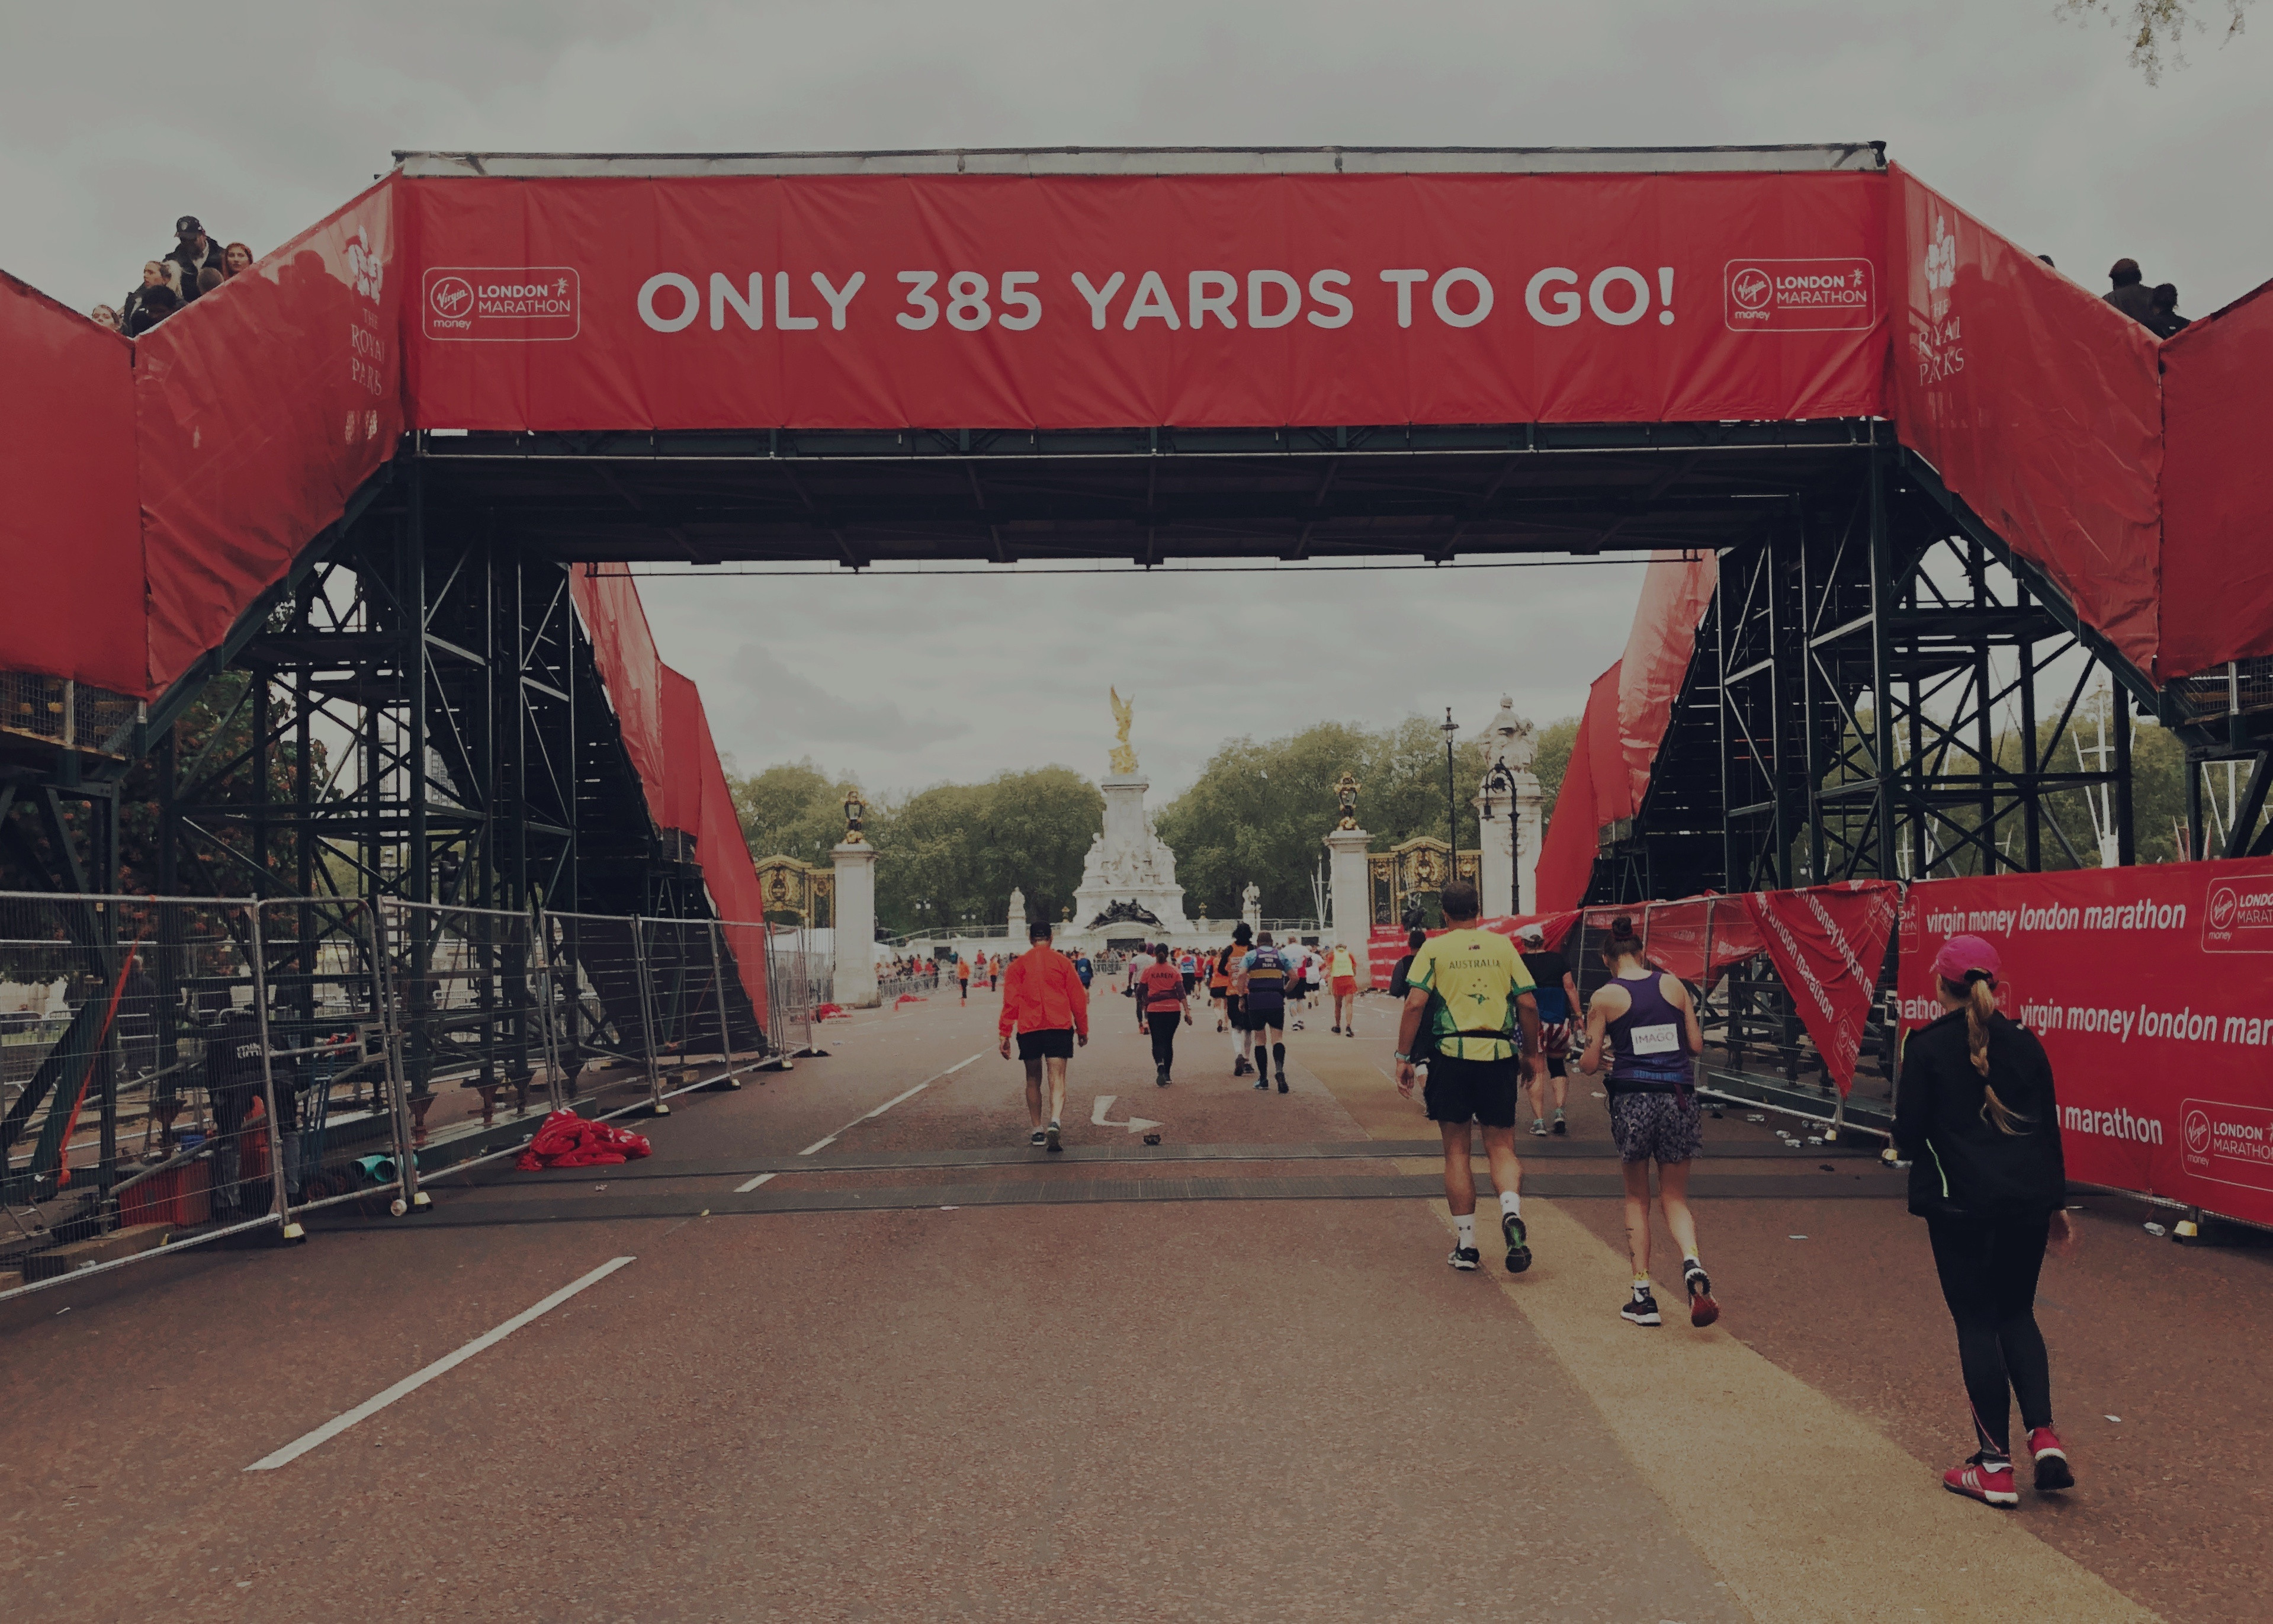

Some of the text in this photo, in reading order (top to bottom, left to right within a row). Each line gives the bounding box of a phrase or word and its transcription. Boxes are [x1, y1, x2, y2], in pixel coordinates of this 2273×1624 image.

[478, 284, 548, 298] LONDON
[1777, 275, 1845, 288] LONDON
[437, 284, 468, 311] Virgin
[479, 299, 570, 313] MARATHON
[637, 266, 1675, 333] ONLY 385 YARDS TO GO!
[1777, 290, 1867, 304] MARATHON
[363, 307, 378, 329] THE
[434, 320, 471, 330] money
[1735, 311, 1770, 320] money
[1809, 894, 1839, 946] money
[1927, 905, 1965, 940] virgin
[1968, 909, 2017, 939] money
[2018, 901, 2079, 930] london
[2083, 898, 2187, 930] marathon
[2208, 932, 2232, 942] money
[2020, 997, 2273, 1046] virgin money london mar
[1635, 1031, 1674, 1044] IMAGO
[2065, 1106, 2163, 1145] marathon
[2188, 1116, 2207, 1146] Virgin
[2213, 1121, 2263, 1141] LONDON
[2213, 1138, 2273, 1160] MARATHO
[2187, 1154, 2210, 1168] money
